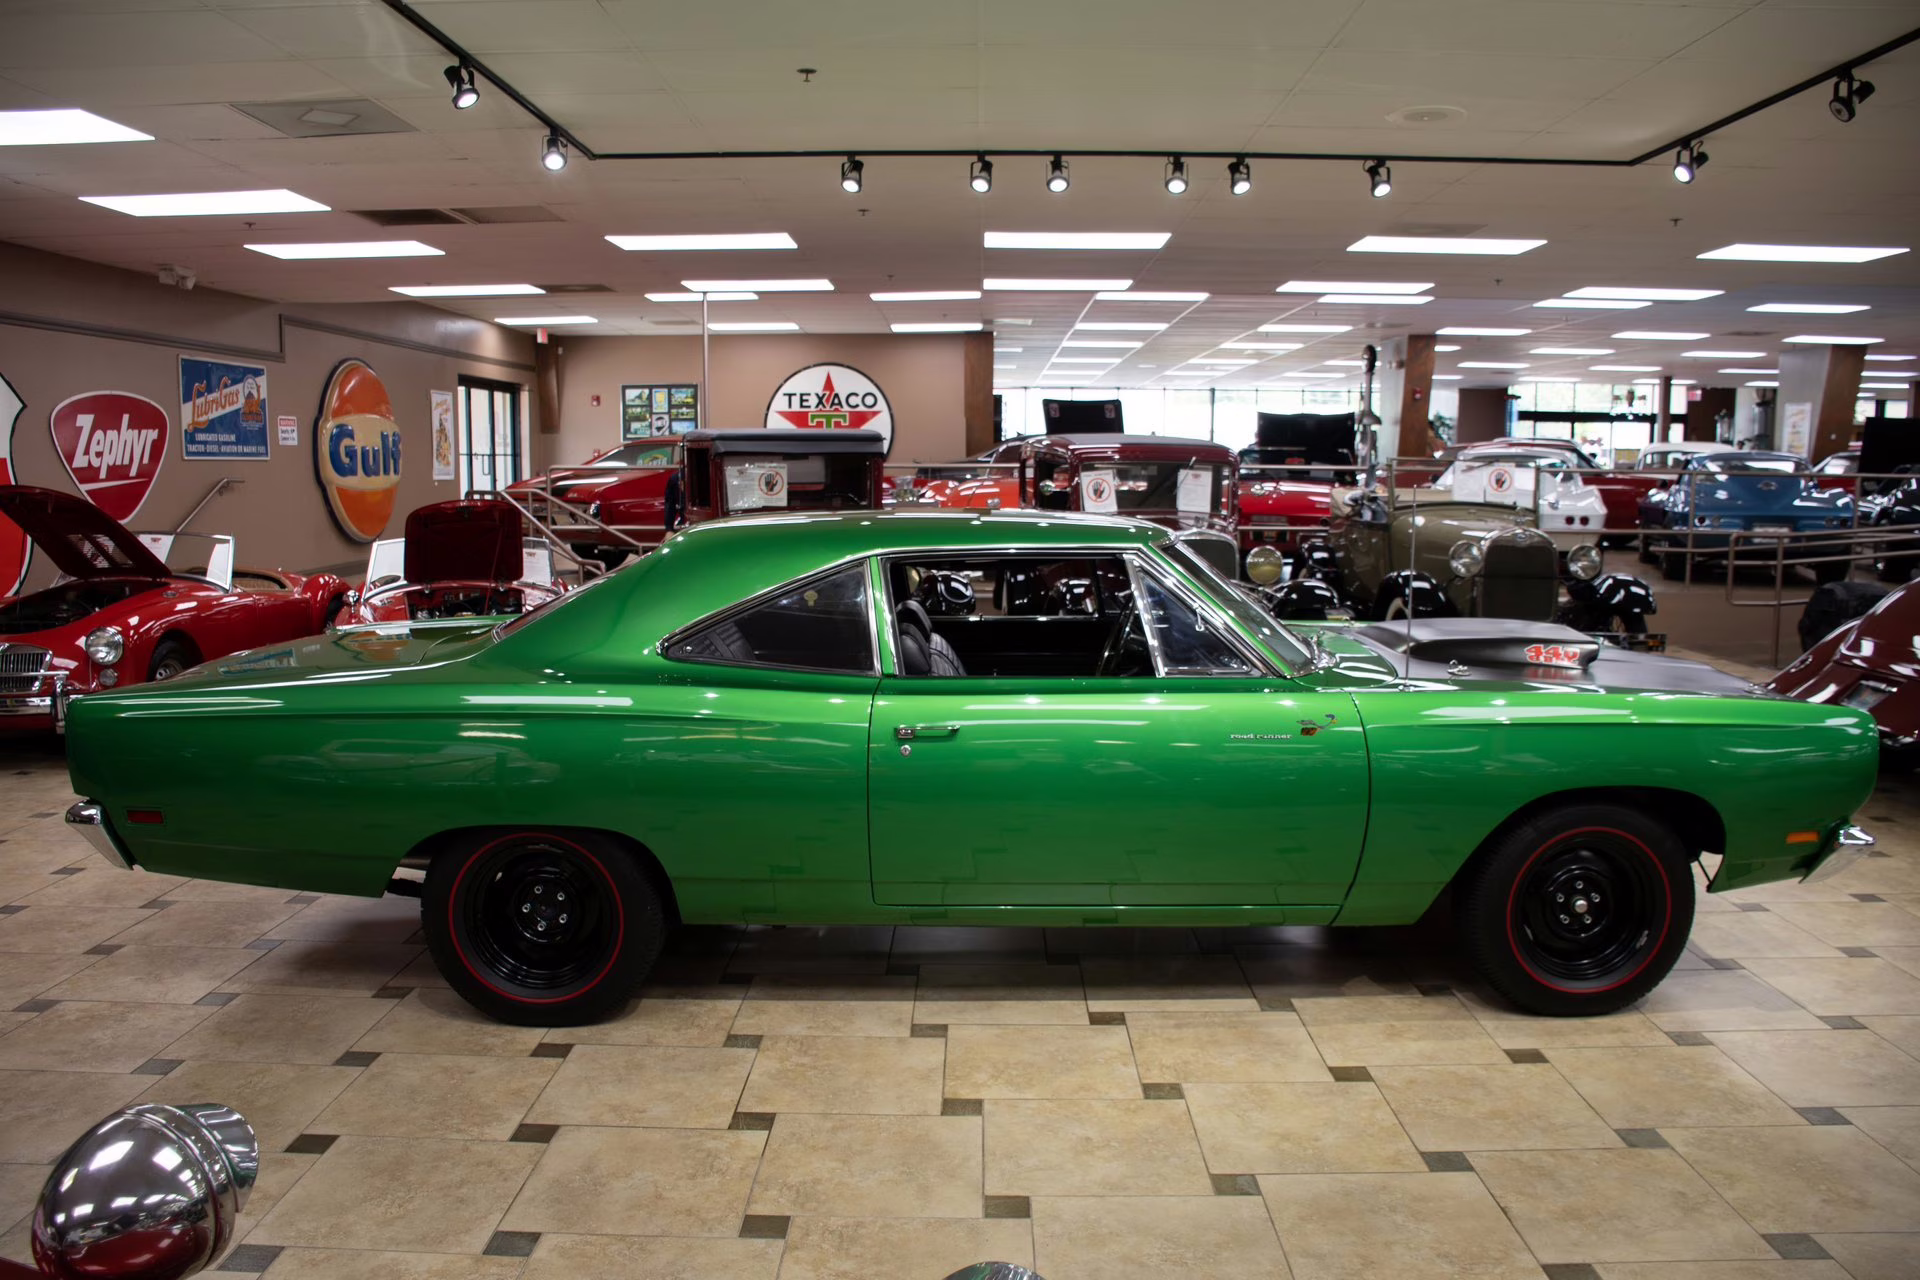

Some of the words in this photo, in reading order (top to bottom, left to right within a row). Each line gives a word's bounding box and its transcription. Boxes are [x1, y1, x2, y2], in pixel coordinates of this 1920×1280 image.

[783, 392, 878, 409] TEXACO
[72, 413, 159, 479] Zephyr
[195, 433, 218, 441] LUBRICATED
[218, 433, 237, 442] GASOLINE
[329, 423, 401, 478] Gulf
